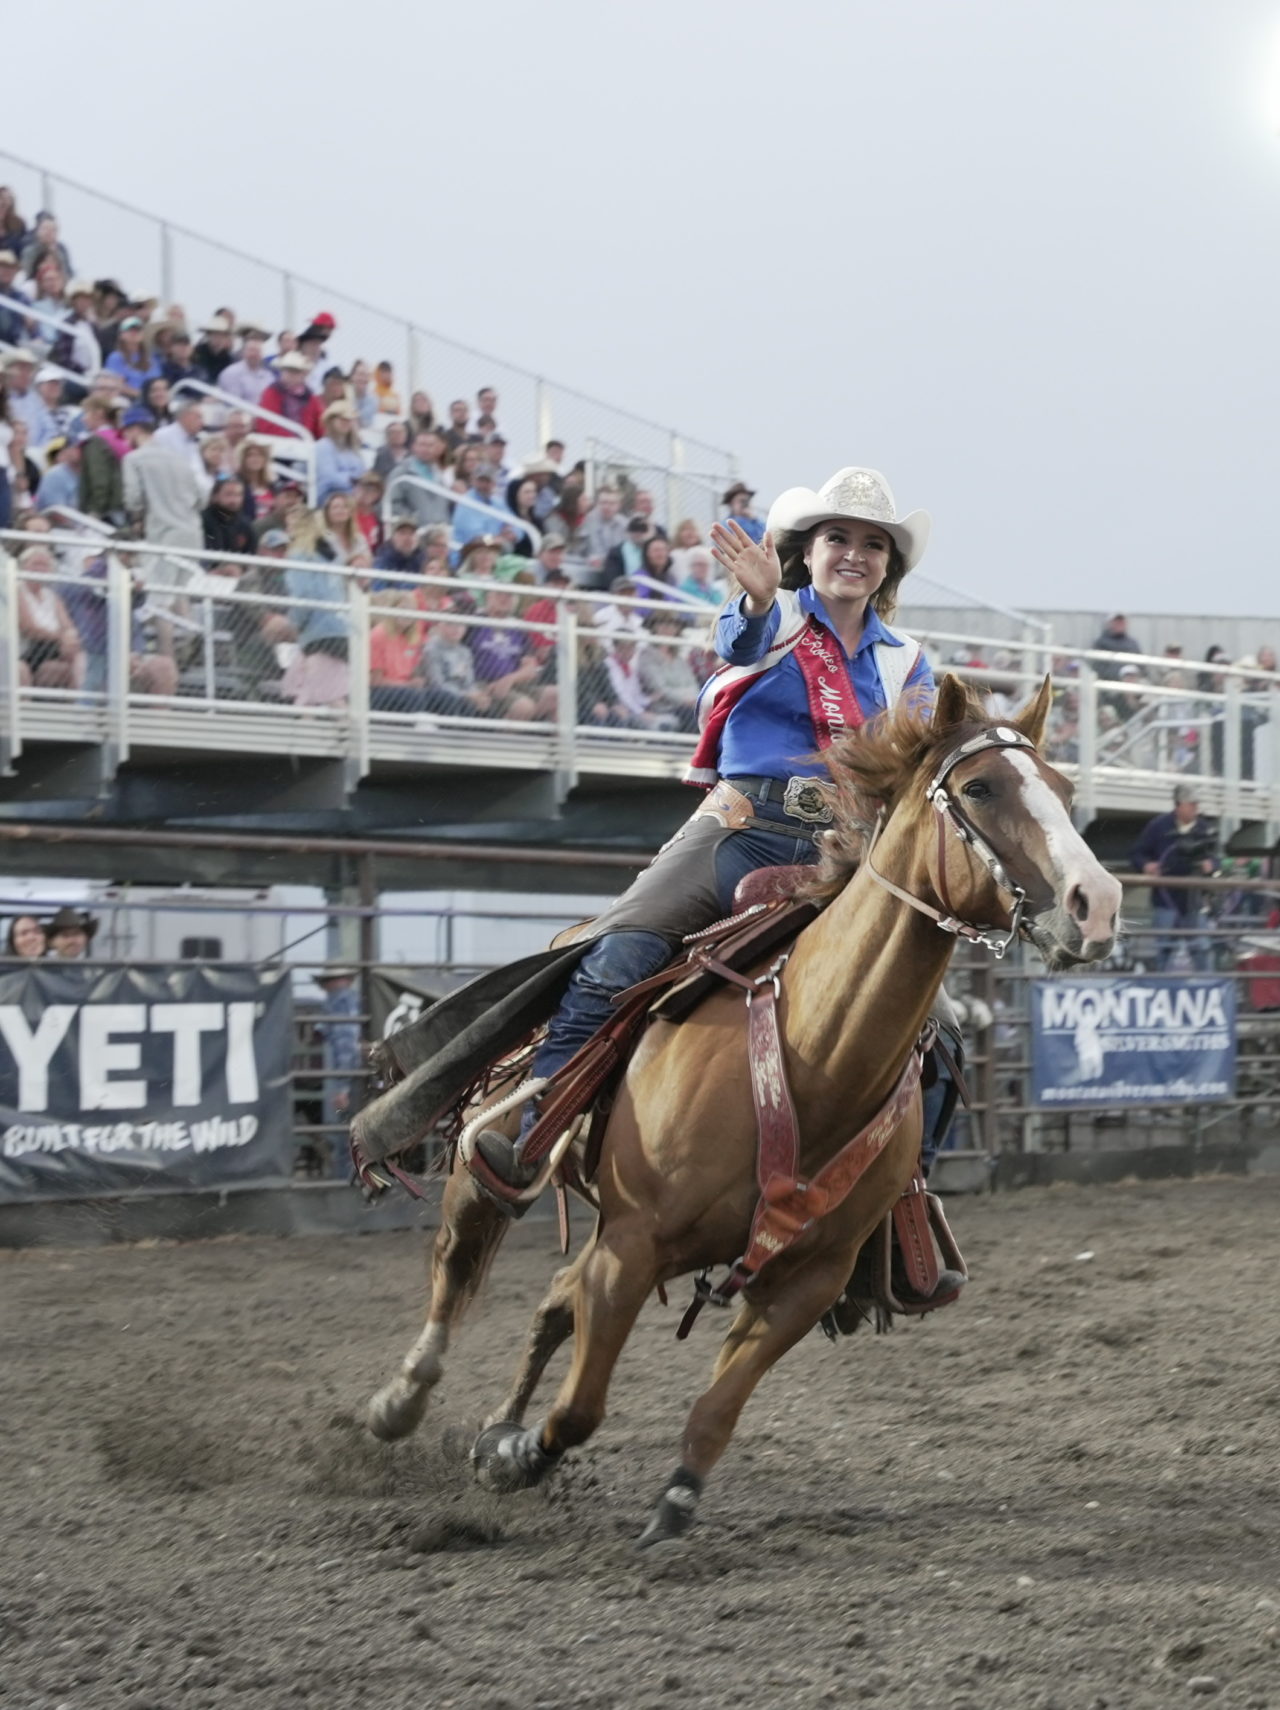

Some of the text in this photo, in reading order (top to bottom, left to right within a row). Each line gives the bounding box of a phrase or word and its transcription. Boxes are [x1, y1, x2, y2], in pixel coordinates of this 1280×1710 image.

[801, 637, 838, 673] Rodeo
[1041, 986, 1227, 1029] MONTANA
[0, 1002, 260, 1113] YETI
[3, 1113, 259, 1158] BUILT FOR THE WILD
